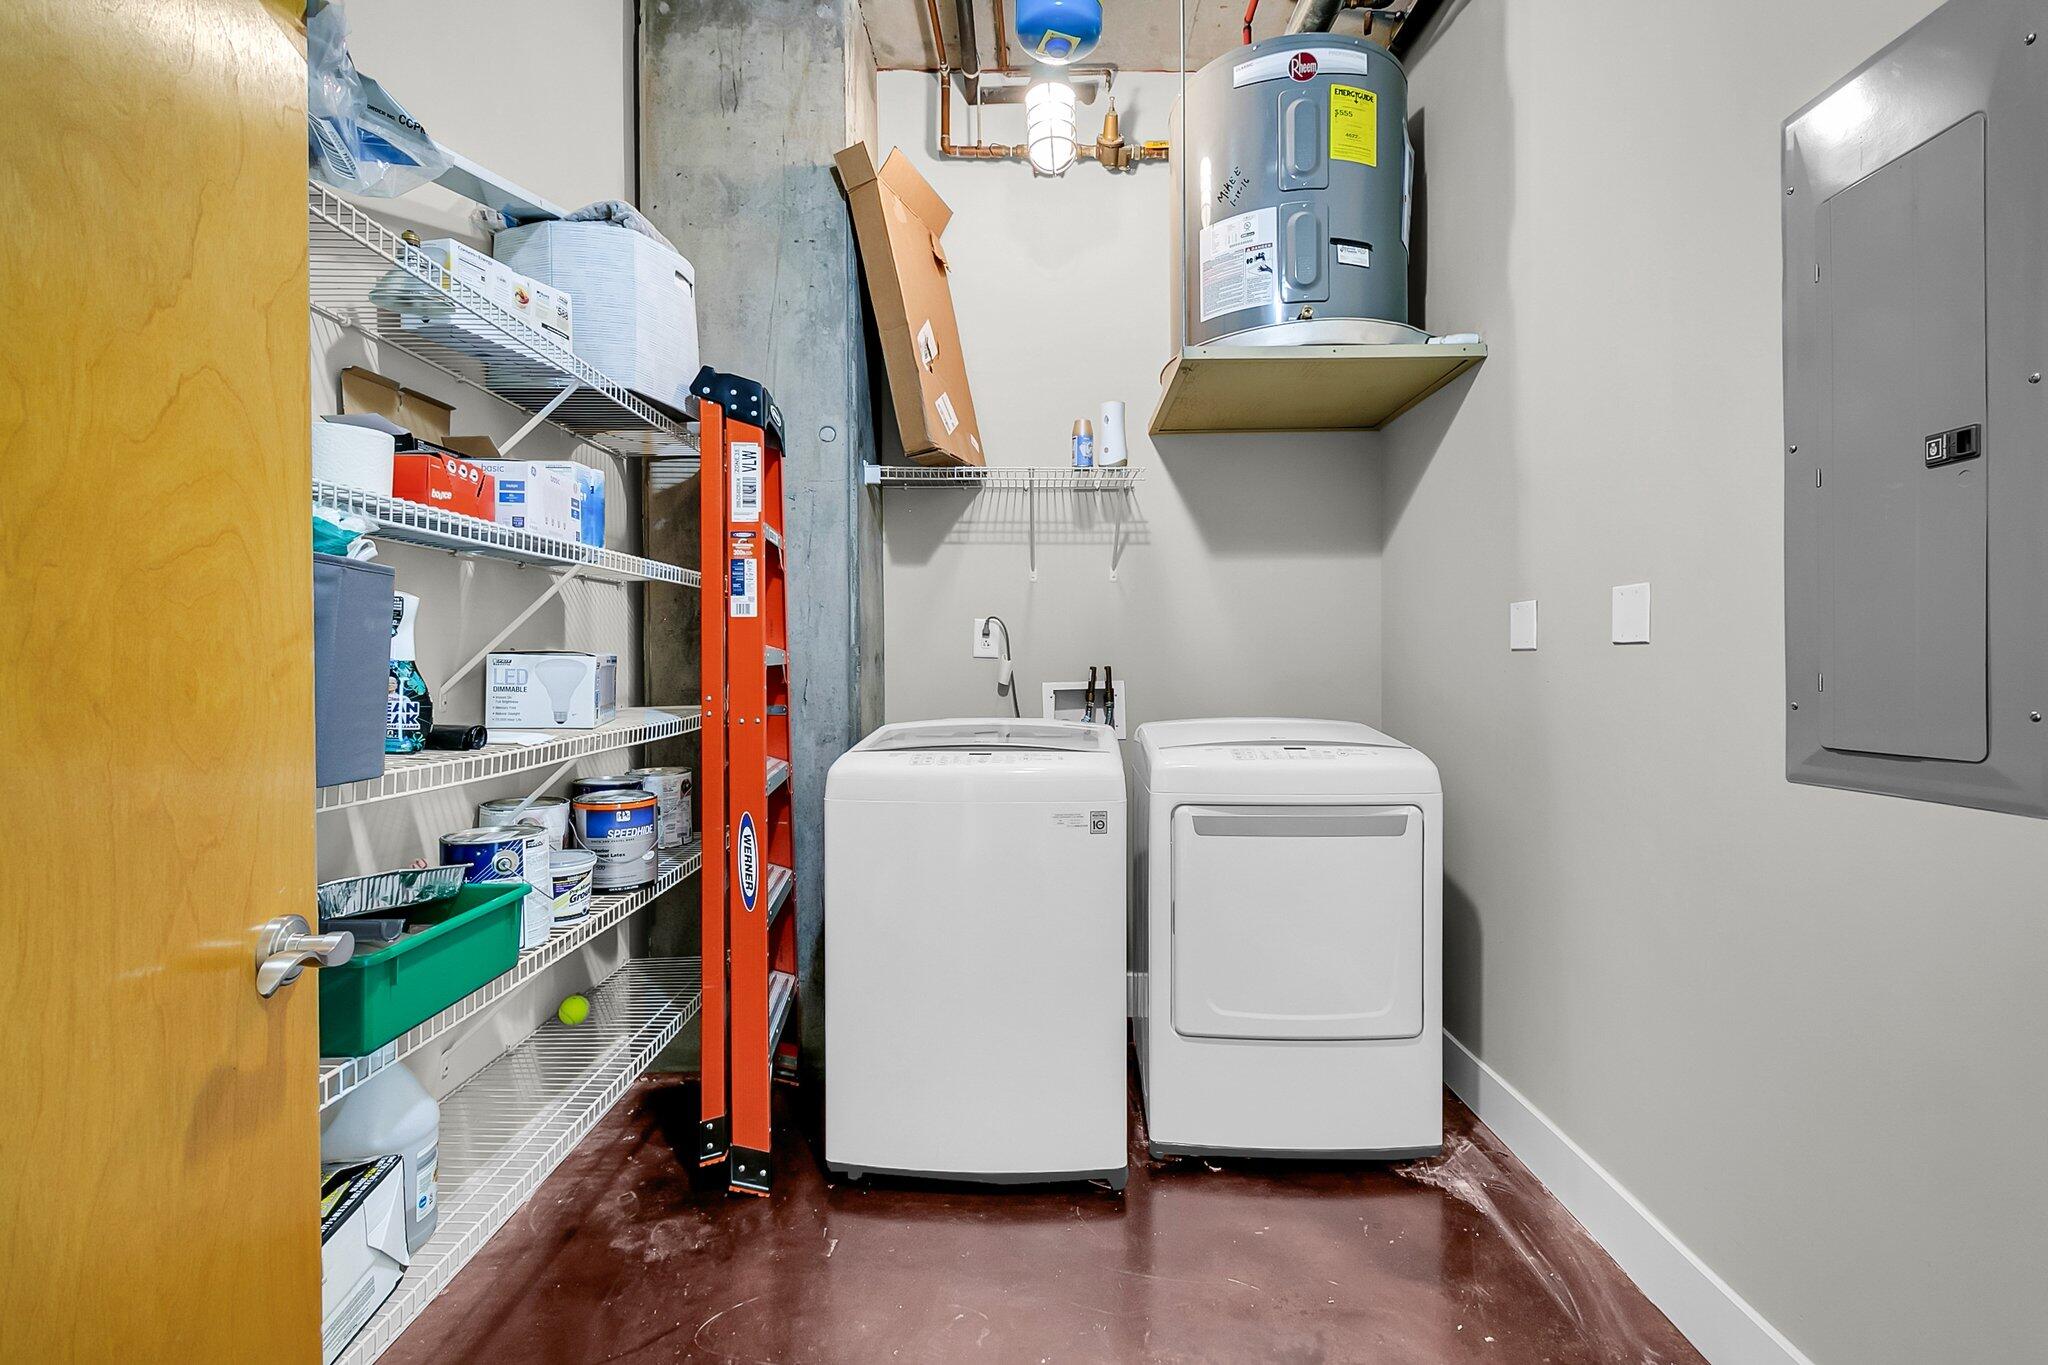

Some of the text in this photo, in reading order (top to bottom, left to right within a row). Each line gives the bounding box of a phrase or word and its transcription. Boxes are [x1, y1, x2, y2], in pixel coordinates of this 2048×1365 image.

[1291, 53, 1317, 78] Rheem
[1334, 109, 1353, 117] $555
[481, 464, 505, 473] basic
[741, 450, 757, 472] VLW
[493, 668, 529, 686] LED
[386, 702, 418, 713] EAN
[386, 713, 418, 724] EAK
[607, 824, 653, 839] SPEEDHIDE
[743, 834, 754, 891] WERNER
